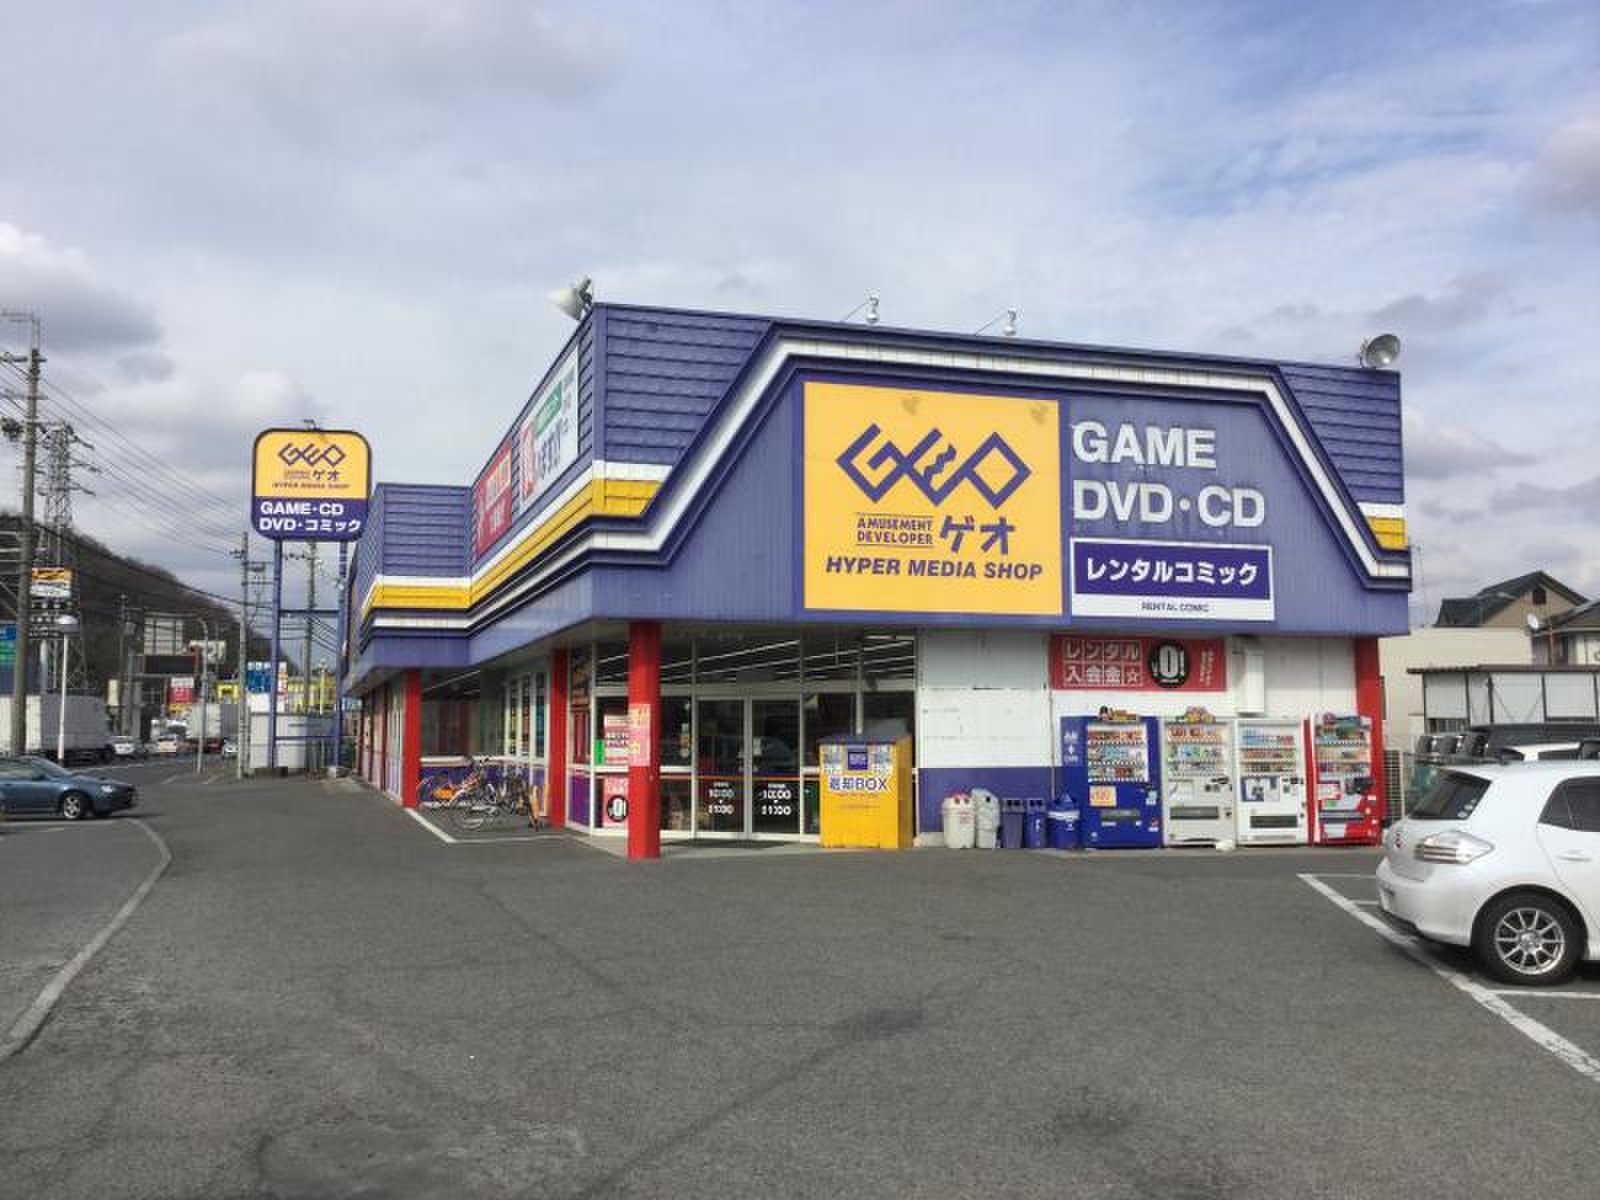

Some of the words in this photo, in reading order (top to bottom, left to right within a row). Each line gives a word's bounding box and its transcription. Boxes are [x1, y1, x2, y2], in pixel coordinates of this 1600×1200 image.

[278, 443, 346, 467] GEO
[1072, 421, 1217, 469] GAME
[313, 469, 341, 481] ゲオ
[836, 423, 1032, 510] GEO
[857, 517, 933, 531] AMUSEMENT
[940, 515, 1016, 555] ゲオ
[857, 531, 933, 545] DEVELOPER
[826, 556, 901, 576] HYPER
[907, 559, 977, 579] MEDIA
[983, 562, 1043, 580] SHOP
[1087, 558, 1258, 586] レンタルコミック
[1066, 640, 1139, 660] レンタル
